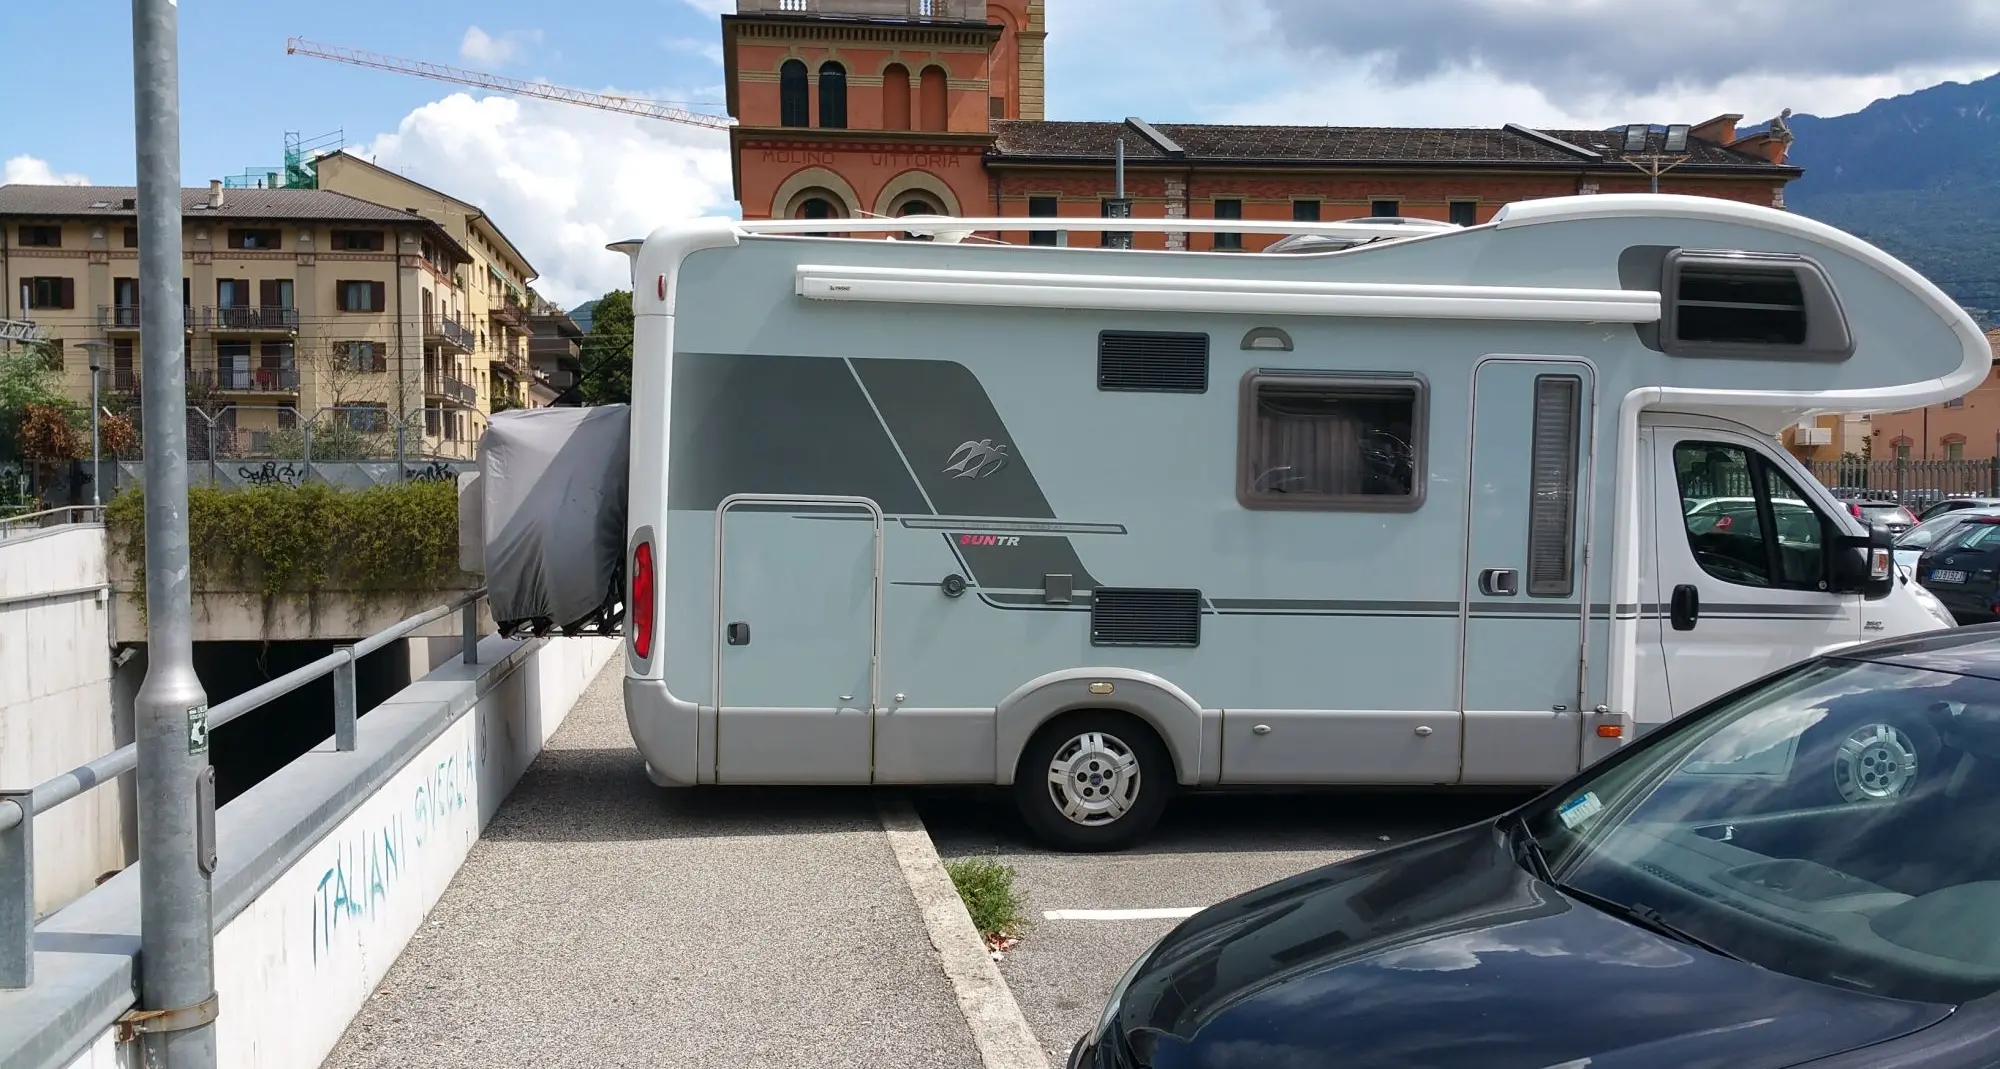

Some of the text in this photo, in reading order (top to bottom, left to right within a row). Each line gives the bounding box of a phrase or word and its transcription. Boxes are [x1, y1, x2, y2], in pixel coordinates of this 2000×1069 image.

[762, 151, 960, 169] MOLINO VITTORIA
[312, 811, 406, 972] ITALIANI
